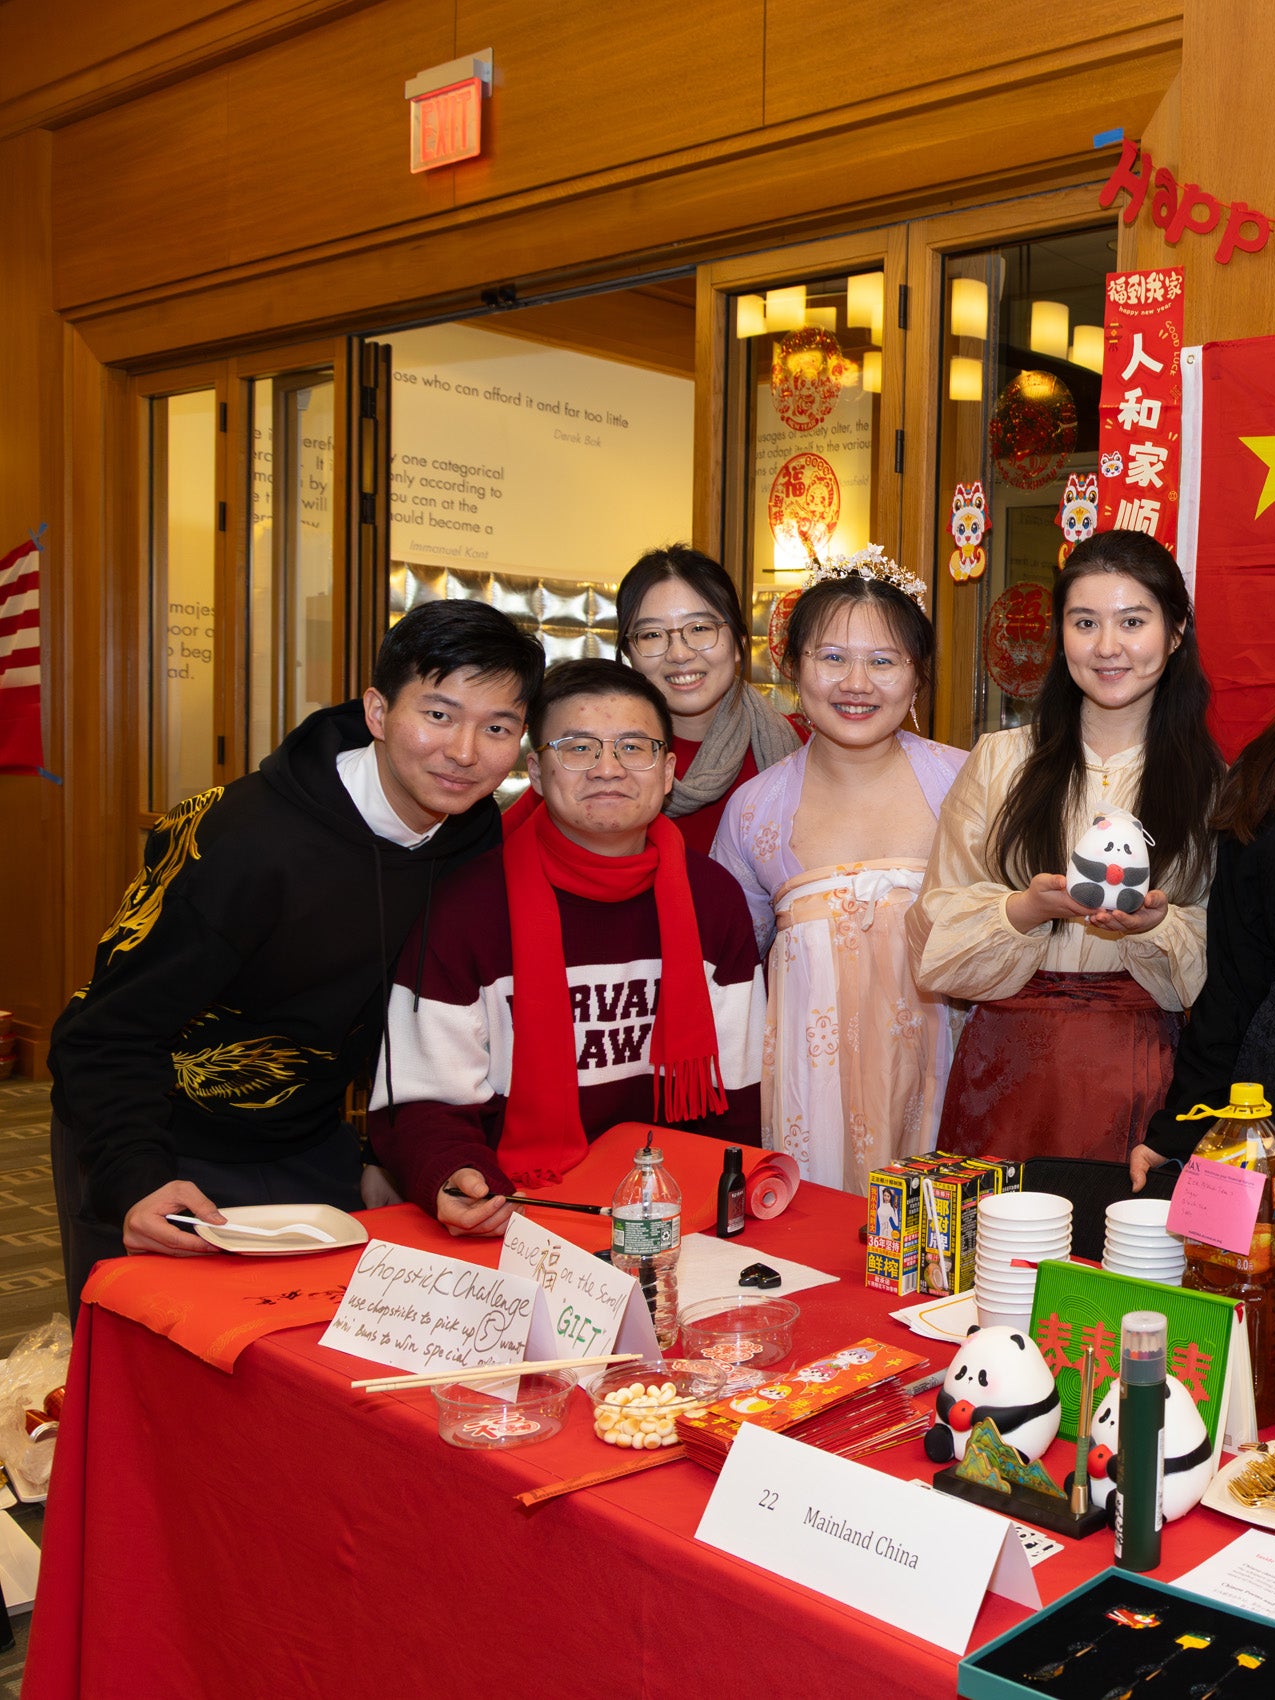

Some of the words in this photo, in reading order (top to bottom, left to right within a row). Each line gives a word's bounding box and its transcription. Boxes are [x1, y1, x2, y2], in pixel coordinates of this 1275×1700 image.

[421, 90, 472, 162] EXIT
[1107, 271, 1183, 305] 福到我家
[1118, 305, 1139, 316] happy
[1140, 308, 1154, 316] new
[1156, 302, 1172, 313] year
[1165, 320, 1180, 347] GOOD
[1169, 351, 1180, 376] LUCK
[422, 374, 451, 391] who
[455, 383, 480, 398] can
[483, 386, 522, 407] afford
[526, 396, 533, 408] it
[537, 400, 561, 415] and
[564, 402, 580, 418] far
[584, 408, 603, 424] too
[606, 411, 630, 429] little
[553, 428, 582, 445] Derek
[856, 418, 870, 432] the
[1114, 333, 1168, 537] 人和家顺
[815, 444, 825, 454] to
[827, 440, 841, 453] the
[401, 454, 428, 468] one
[431, 458, 505, 480] categorical
[309, 474, 328, 495] by
[419, 476, 486, 500] according
[490, 486, 503, 499] to
[783, 464, 806, 498] 福
[302, 498, 328, 512] will
[412, 495, 437, 508] can
[441, 499, 455, 510] at
[458, 497, 478, 514] the
[428, 512, 481, 533] become
[484, 524, 494, 535] a
[409, 540, 463, 557] Immanuel
[464, 546, 489, 560] Kant
[167, 625, 199, 637] oor
[569, 979, 661, 1023] RVA
[868, 1235, 900, 1253] 36年坚持
[503, 1219, 540, 1267] Leave
[532, 1239, 561, 1293] 福
[560, 1267, 573, 1284] on
[577, 1272, 595, 1297] the
[868, 1253, 899, 1278] 鲜榨
[452, 1270, 531, 1330] Challenge
[367, 1299, 418, 1324] chopsticks
[420, 1311, 431, 1326] to
[430, 1315, 459, 1336] pick
[461, 1326, 476, 1346] up
[382, 1330, 391, 1346] to
[423, 1342, 473, 1367] special
[758, 1489, 780, 1511] 22
[803, 1506, 874, 1550] Mainland
[875, 1536, 919, 1570] China
